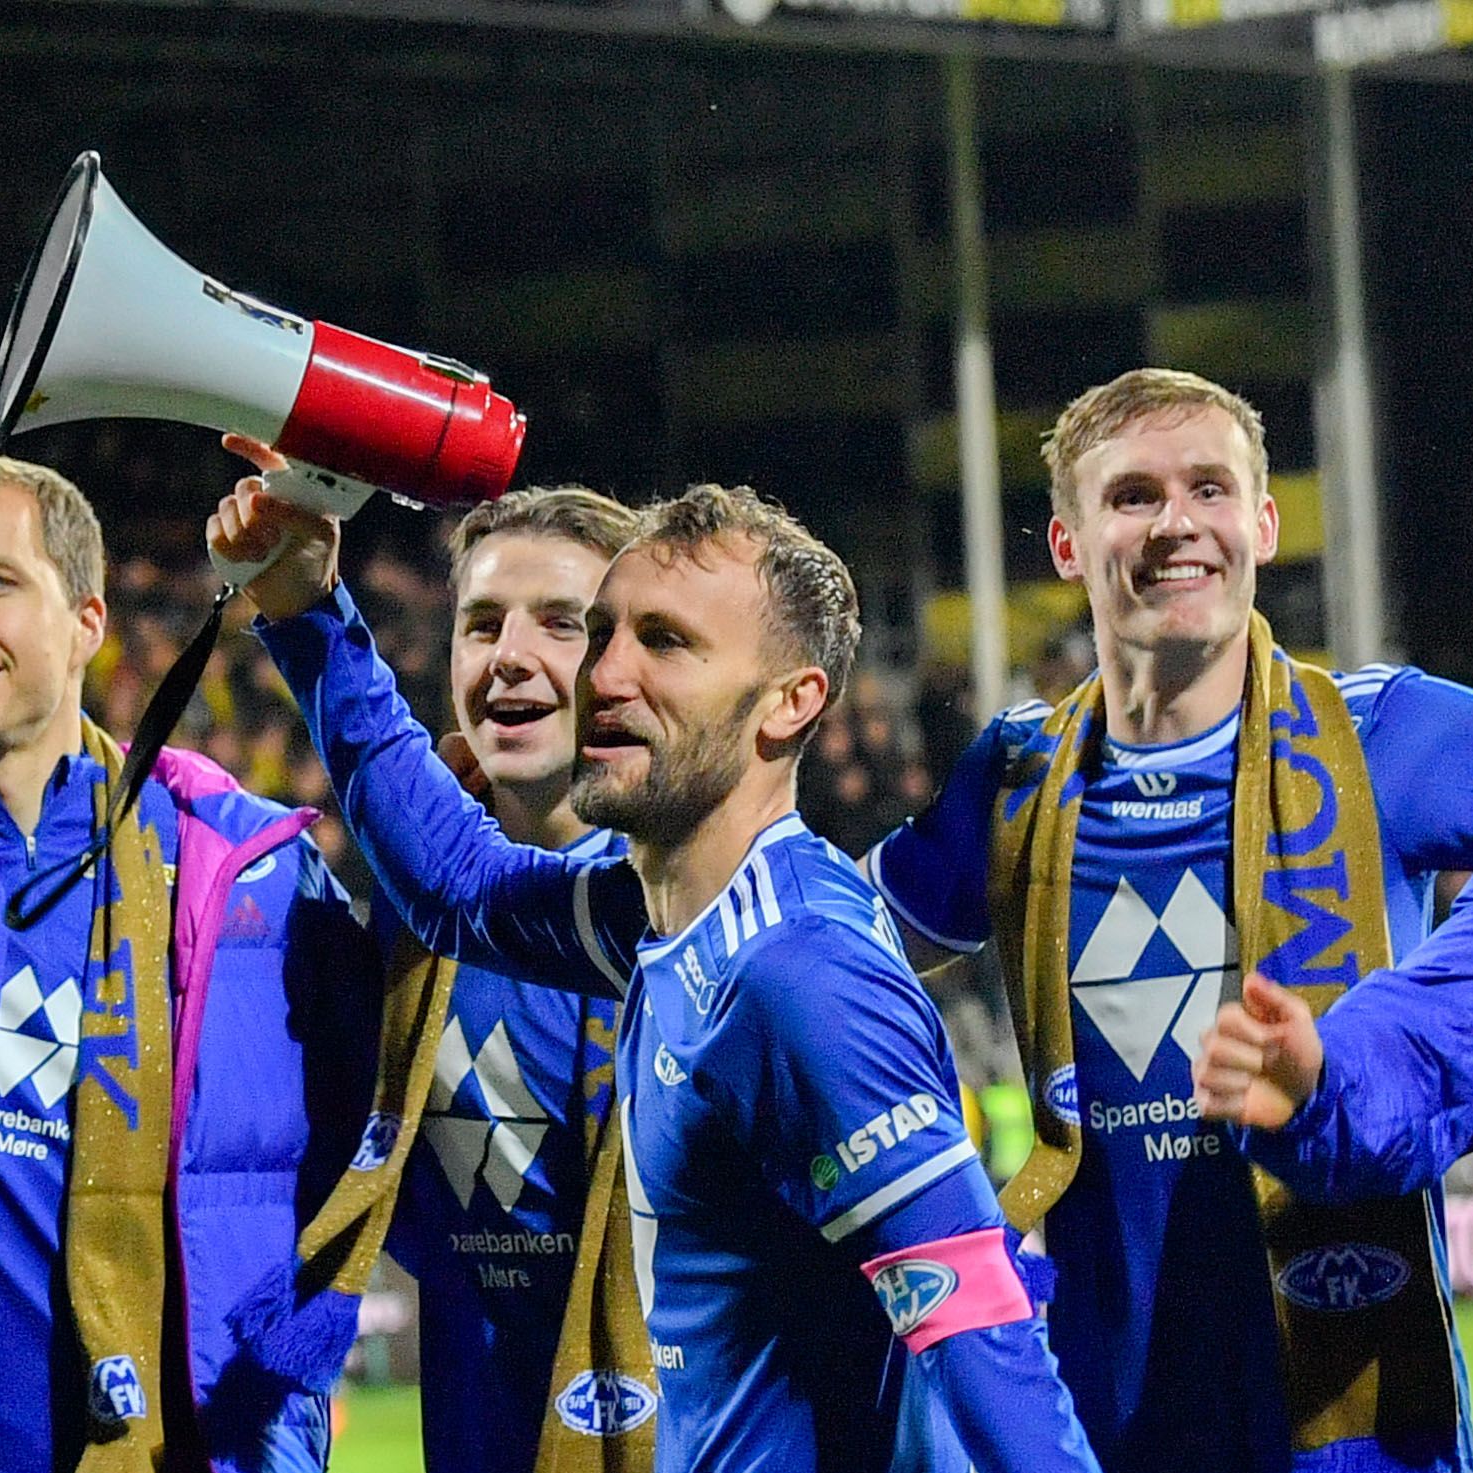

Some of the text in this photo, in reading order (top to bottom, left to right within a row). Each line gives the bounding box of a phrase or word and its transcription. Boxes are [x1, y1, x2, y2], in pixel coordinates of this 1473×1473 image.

[1111, 799, 1205, 821] wenaas
[836, 1092, 939, 1173] ISTAD
[1143, 1131, 1221, 1162] Møre
